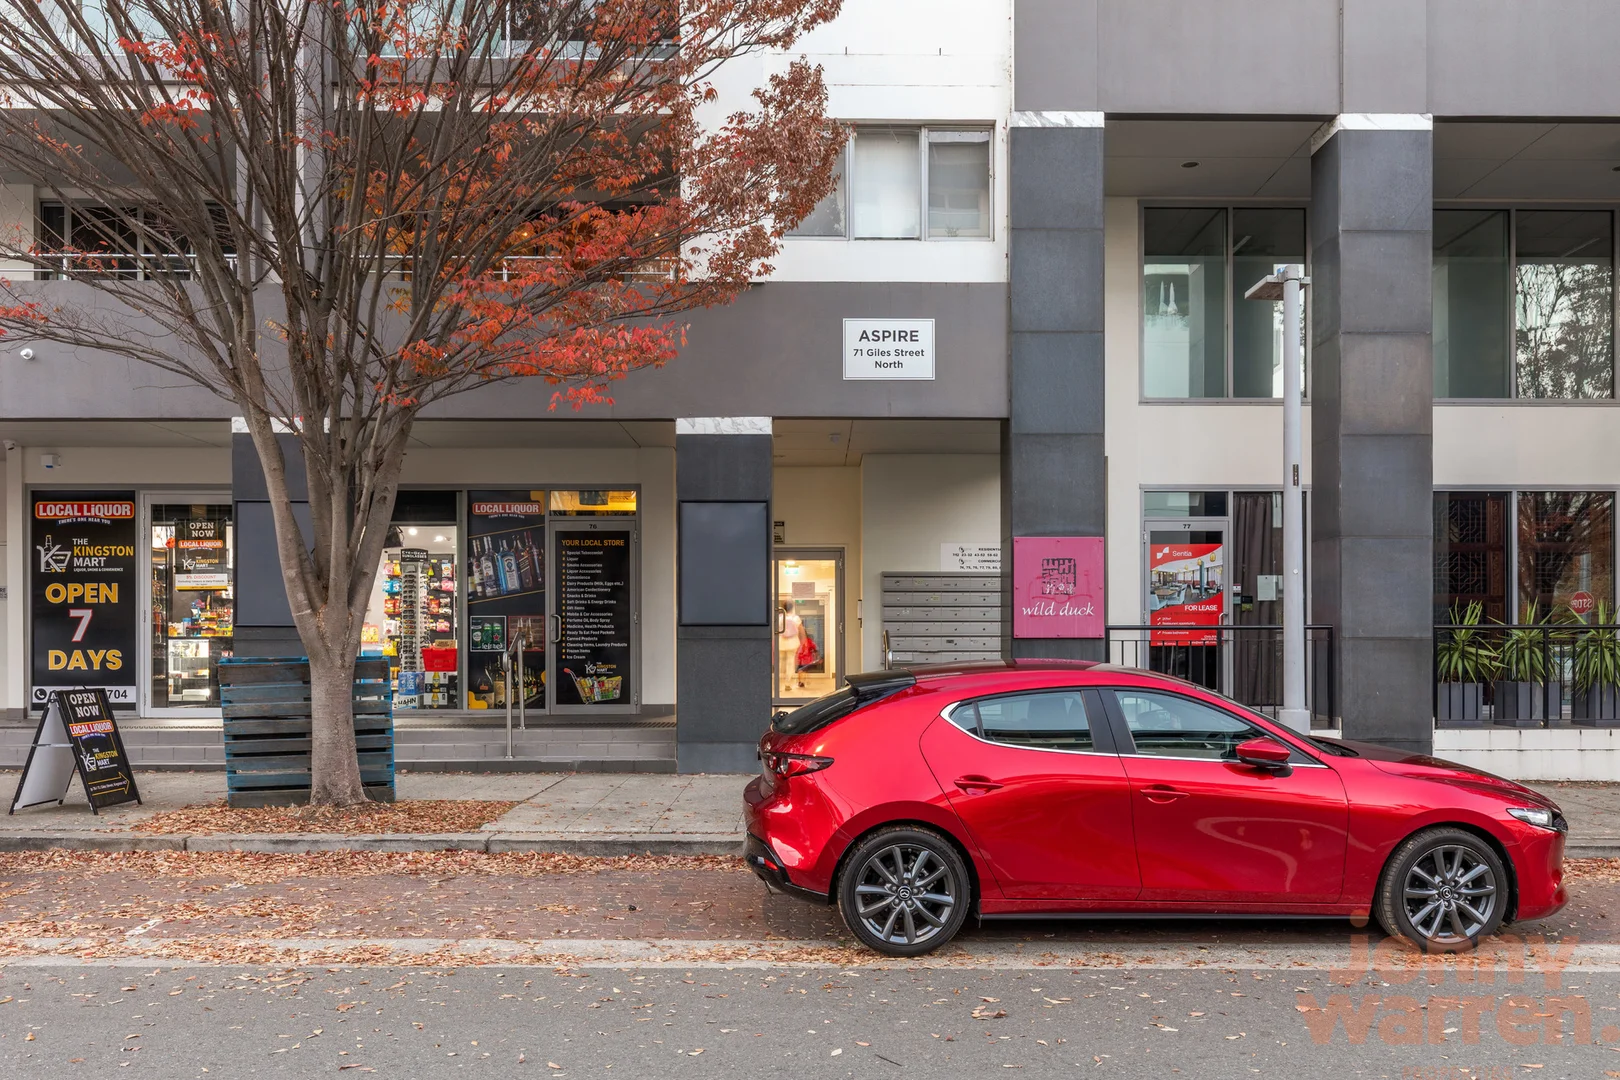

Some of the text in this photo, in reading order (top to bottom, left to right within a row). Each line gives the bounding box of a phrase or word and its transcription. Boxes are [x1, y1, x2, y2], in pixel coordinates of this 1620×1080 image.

[858, 330, 919, 342] ASPIRE
[853, 348, 924, 356] 71 Giles Street
[39, 504, 81, 516] LOCAL
[475, 504, 504, 513] LOCAL
[74, 546, 134, 556] KINGSTON
[74, 557, 106, 566] MART
[45, 583, 119, 603] OPEN
[1022, 602, 1094, 616] wild duck
[69, 608, 93, 642] 7
[48, 650, 122, 670] DAYS
[69, 692, 97, 705] OPEN
[75, 705, 100, 717] NOW
[70, 724, 91, 734] LOCAL
[94, 751, 118, 760] KINGSTON
